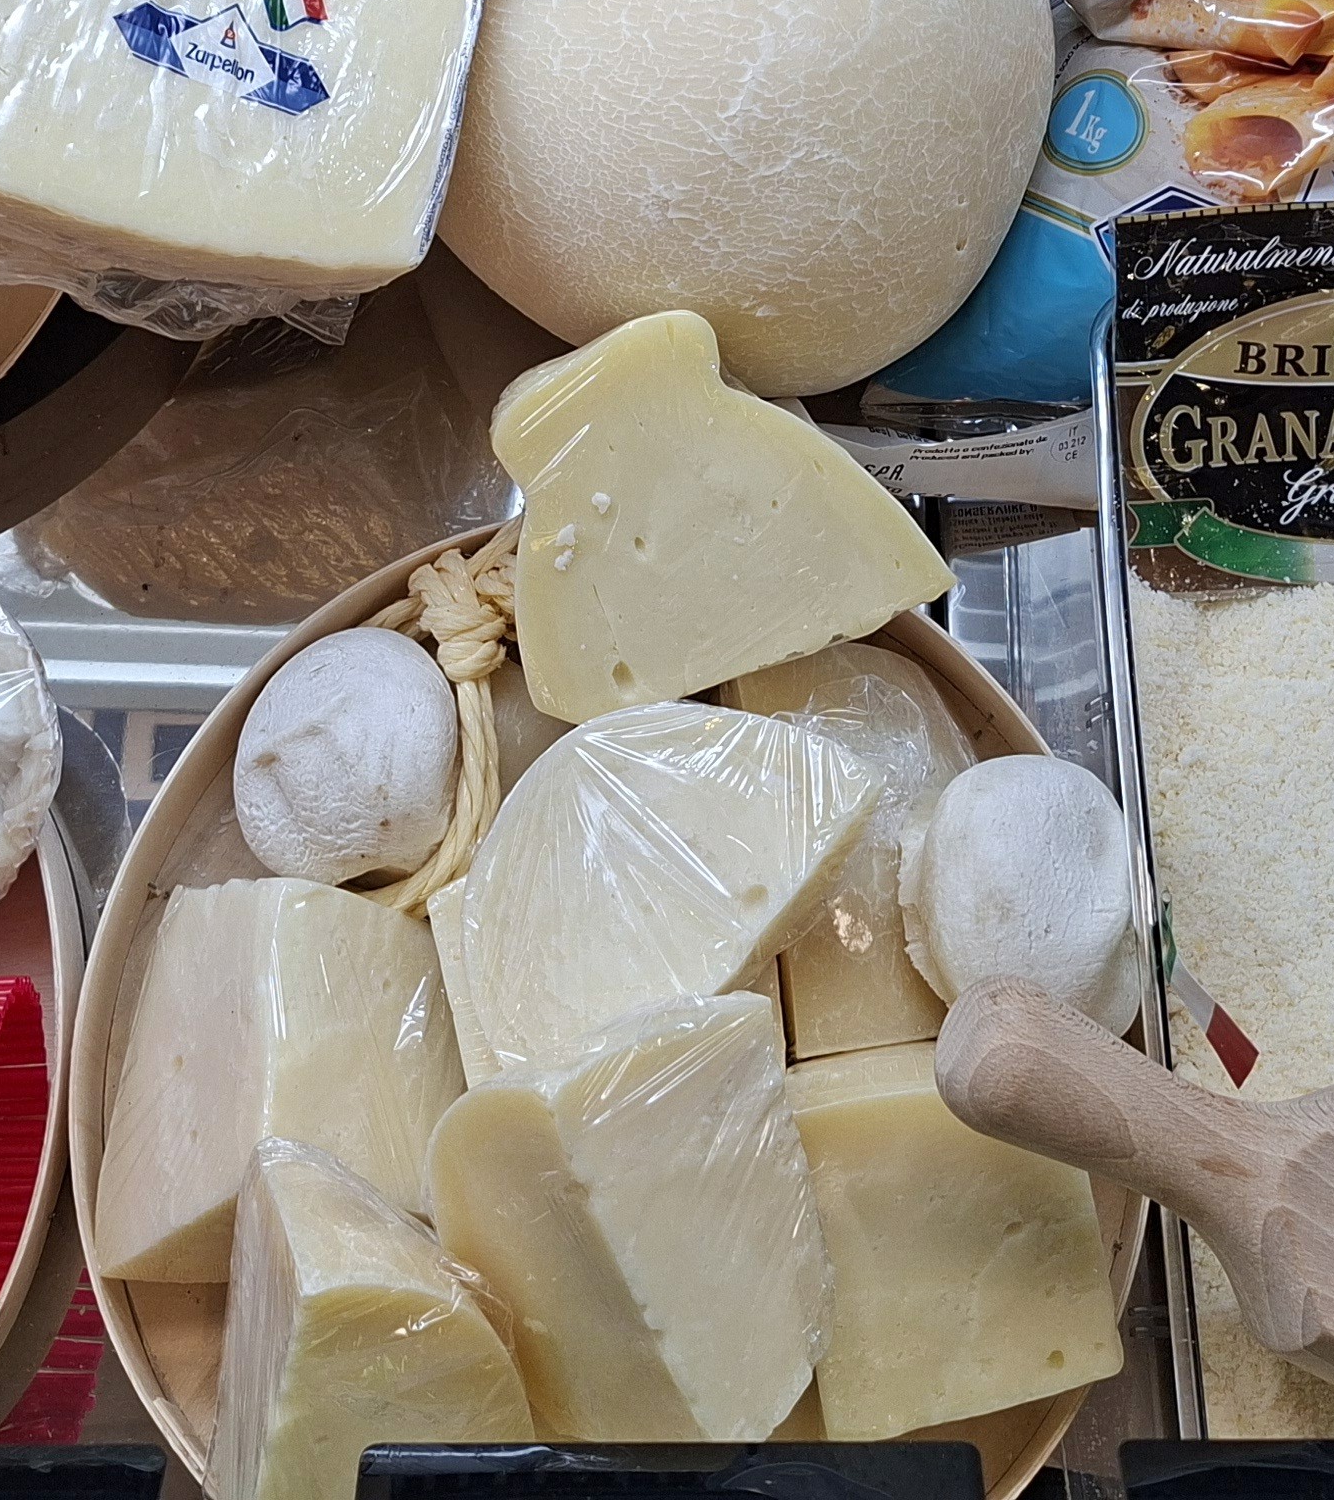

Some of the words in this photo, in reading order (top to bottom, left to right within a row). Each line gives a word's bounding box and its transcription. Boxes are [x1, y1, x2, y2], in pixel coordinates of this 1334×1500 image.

[1142, 296, 1240, 325] produzione
[1068, 426, 1078, 438] IT
[1065, 451, 1078, 462] CE
